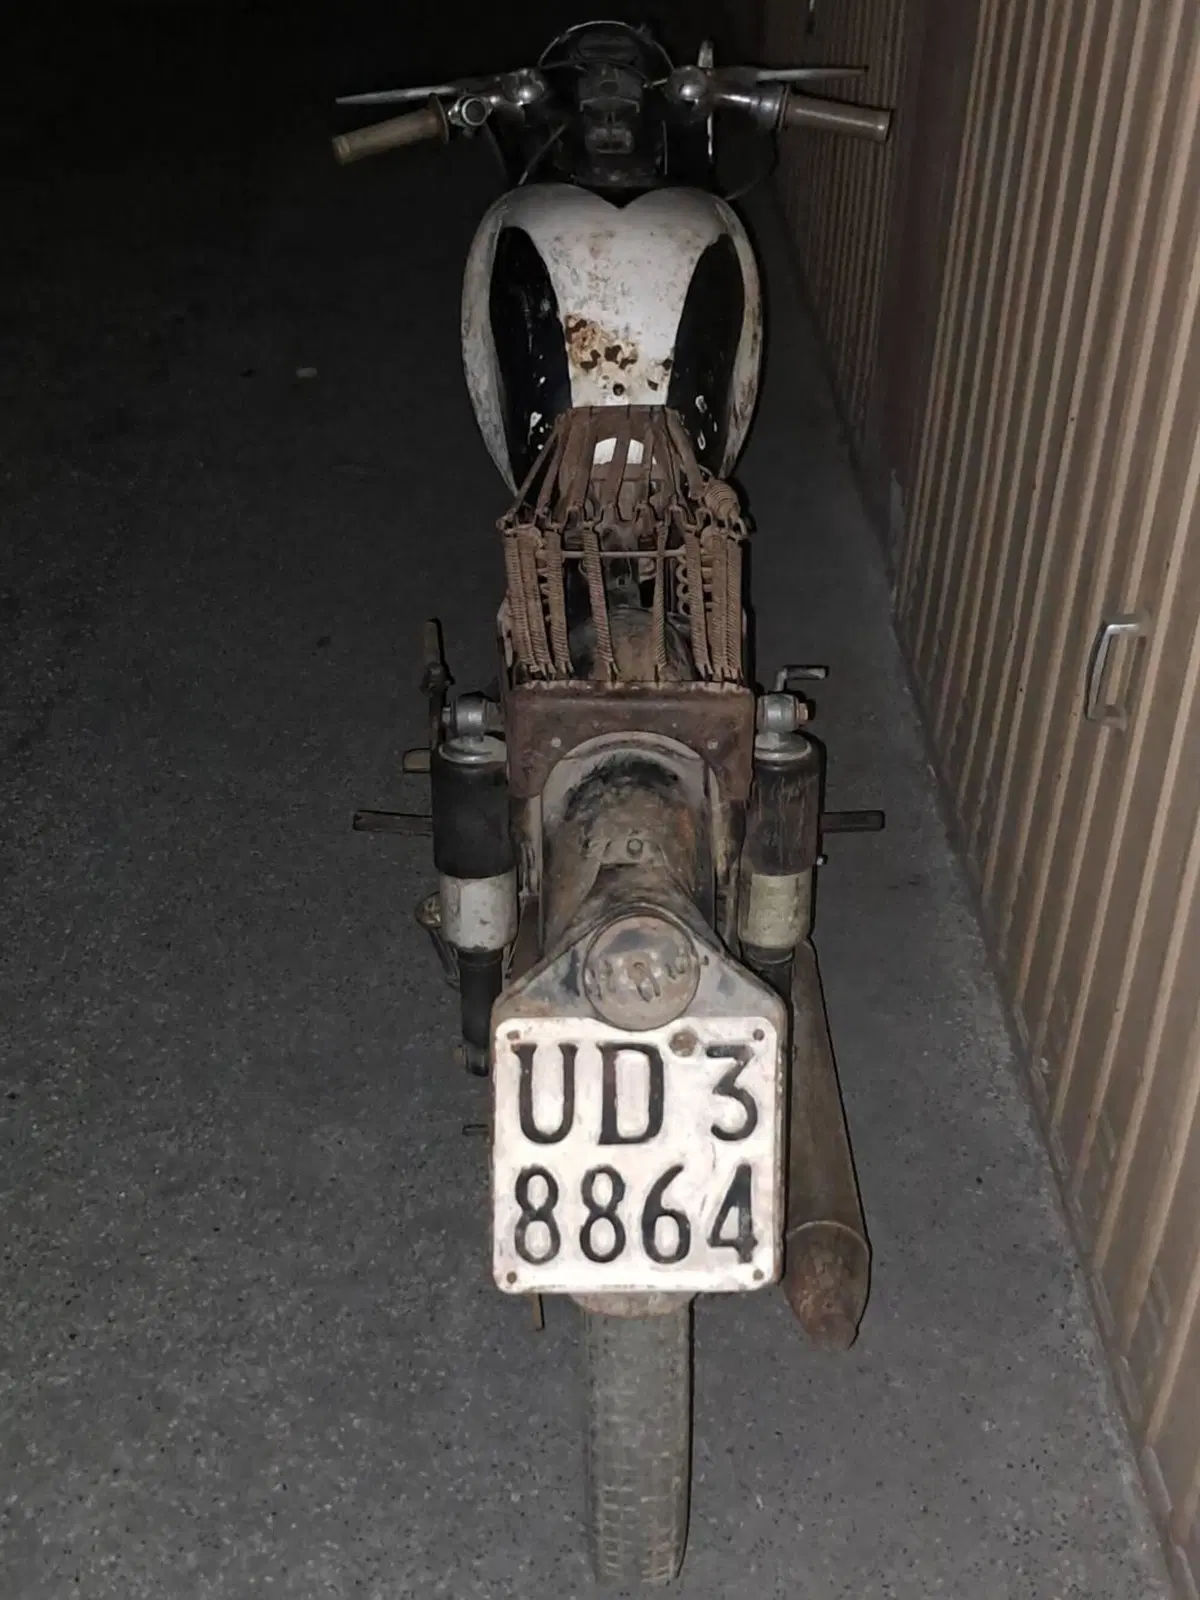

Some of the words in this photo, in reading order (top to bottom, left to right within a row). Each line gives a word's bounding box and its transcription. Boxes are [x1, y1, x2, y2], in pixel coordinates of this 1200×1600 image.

[512, 1042, 664, 1145] UD
[705, 1044, 758, 1142] 3
[514, 1164, 758, 1265] 8864
